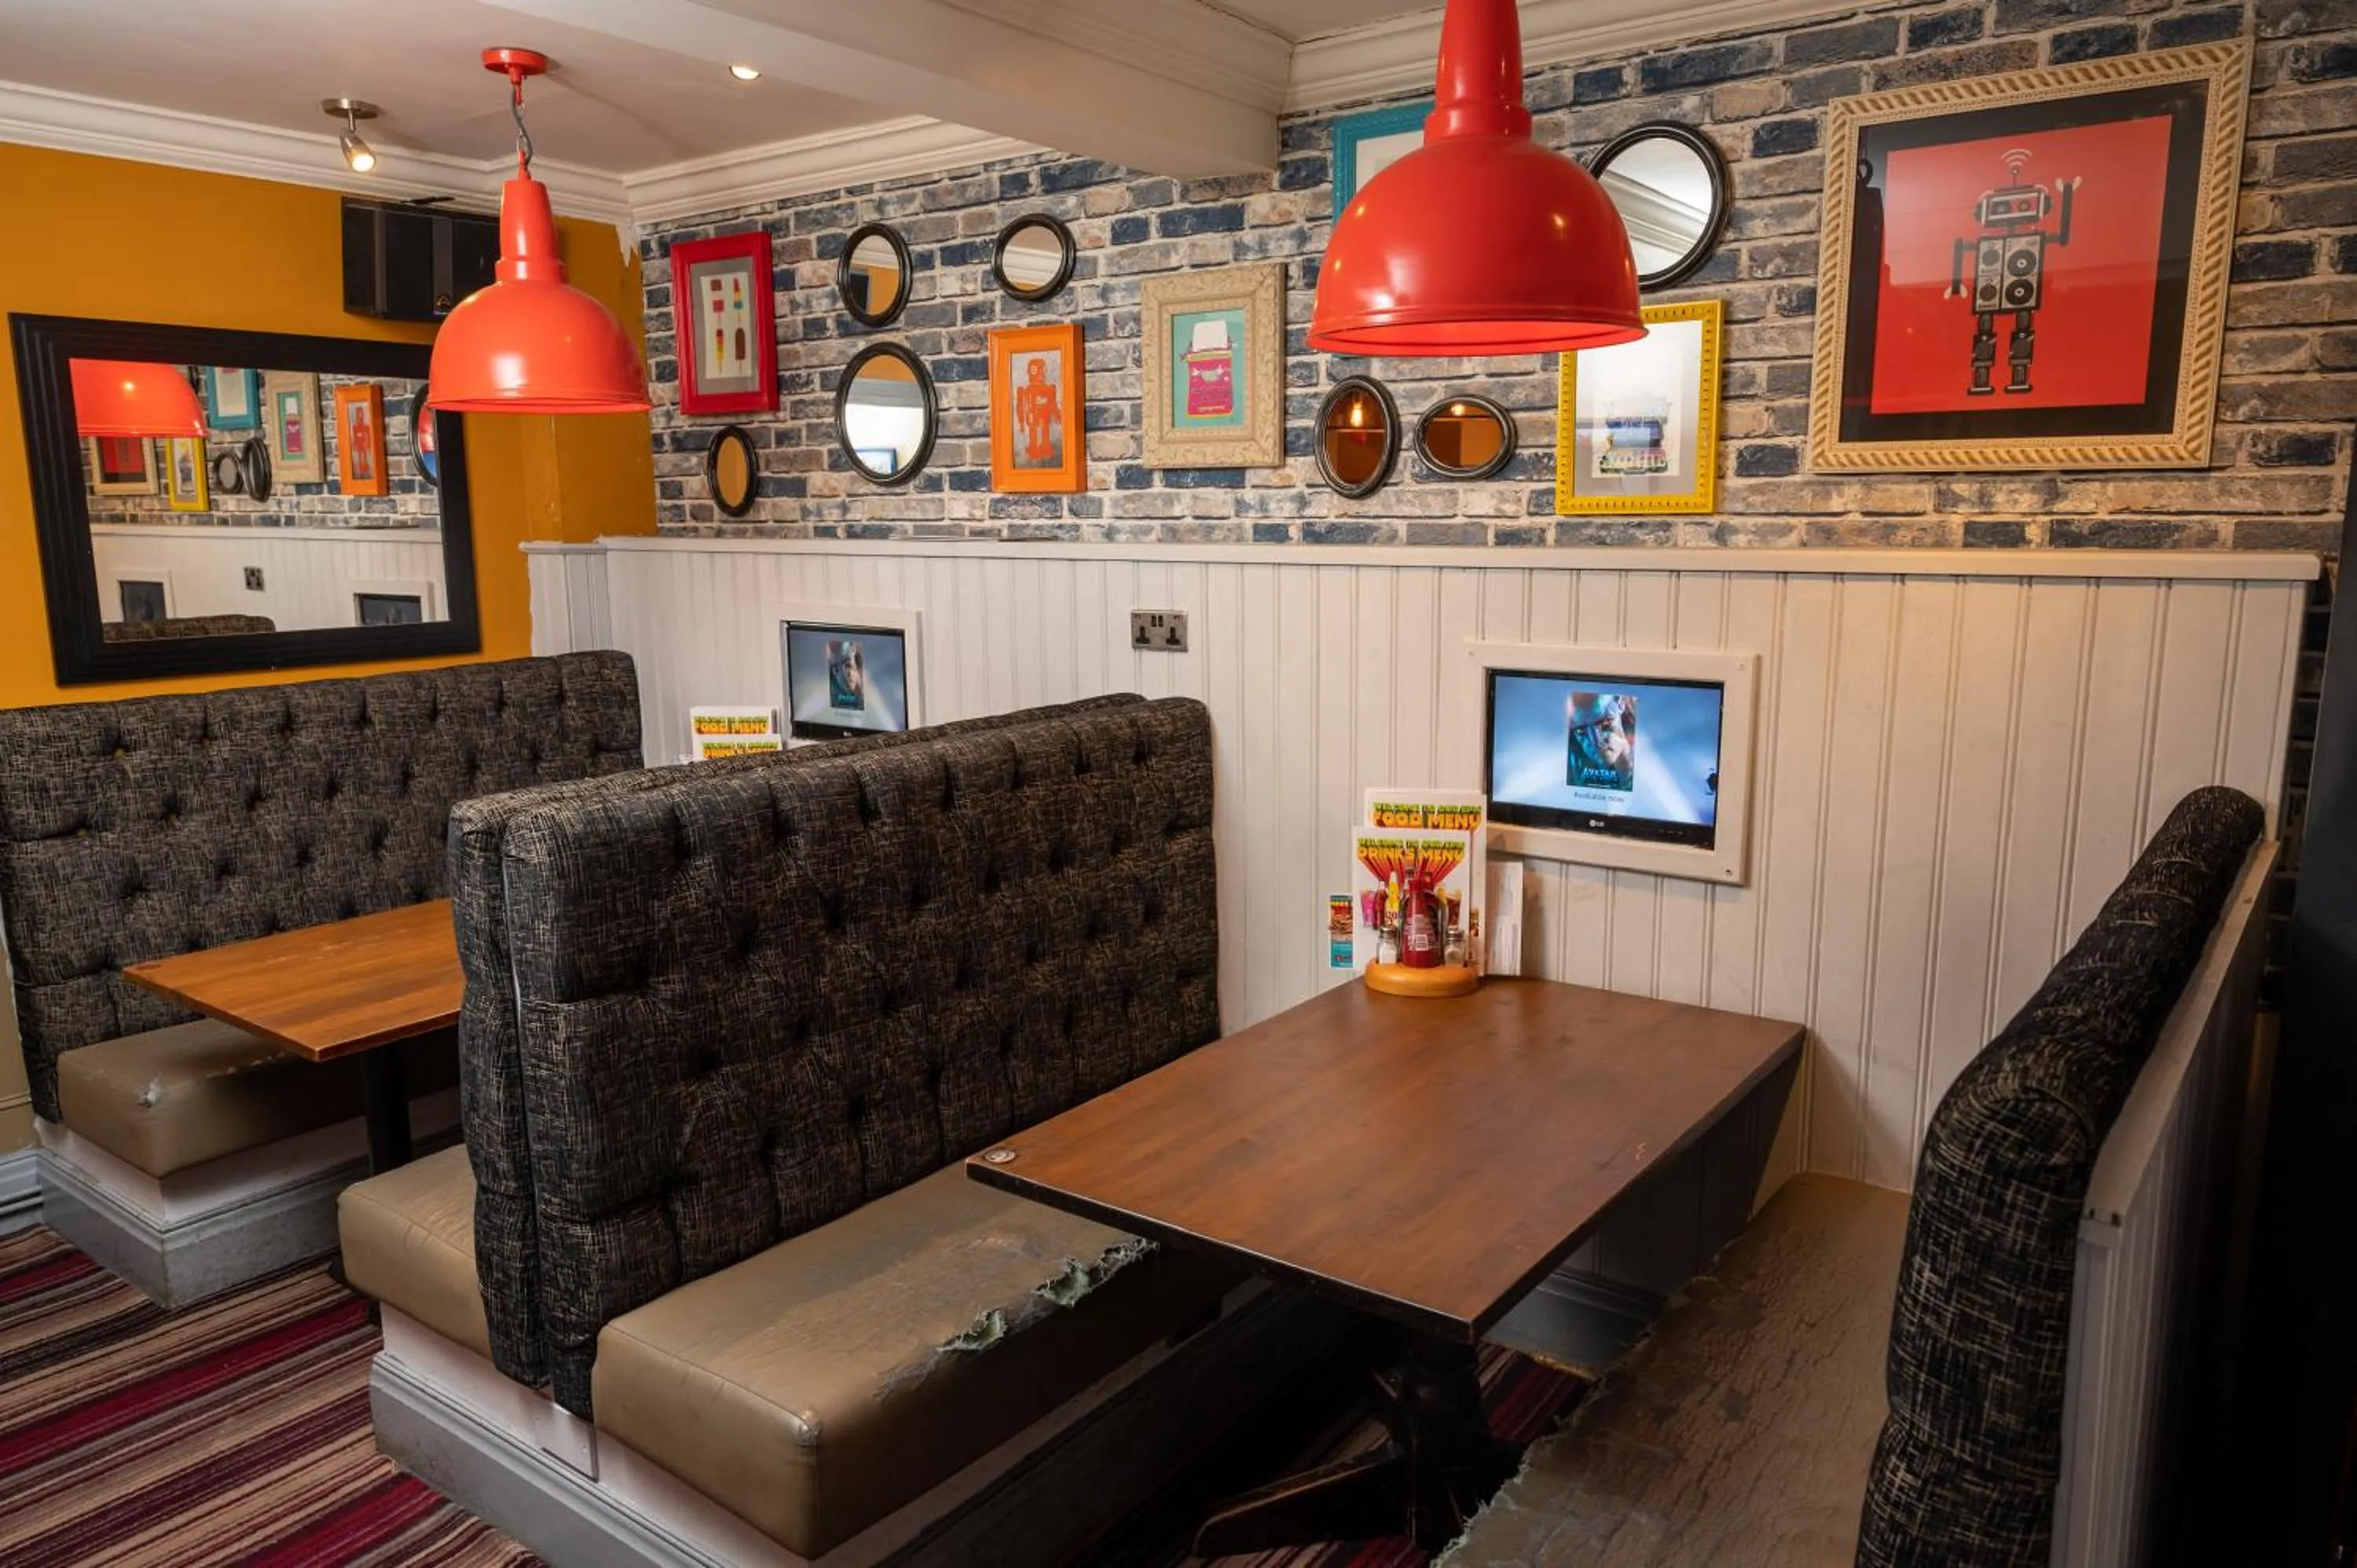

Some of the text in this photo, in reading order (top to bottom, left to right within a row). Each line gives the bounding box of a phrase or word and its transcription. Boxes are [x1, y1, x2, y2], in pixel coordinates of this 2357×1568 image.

[1373, 811, 1483, 830] FOOD MENU
[1358, 848, 1464, 862] DRINKS MENU
